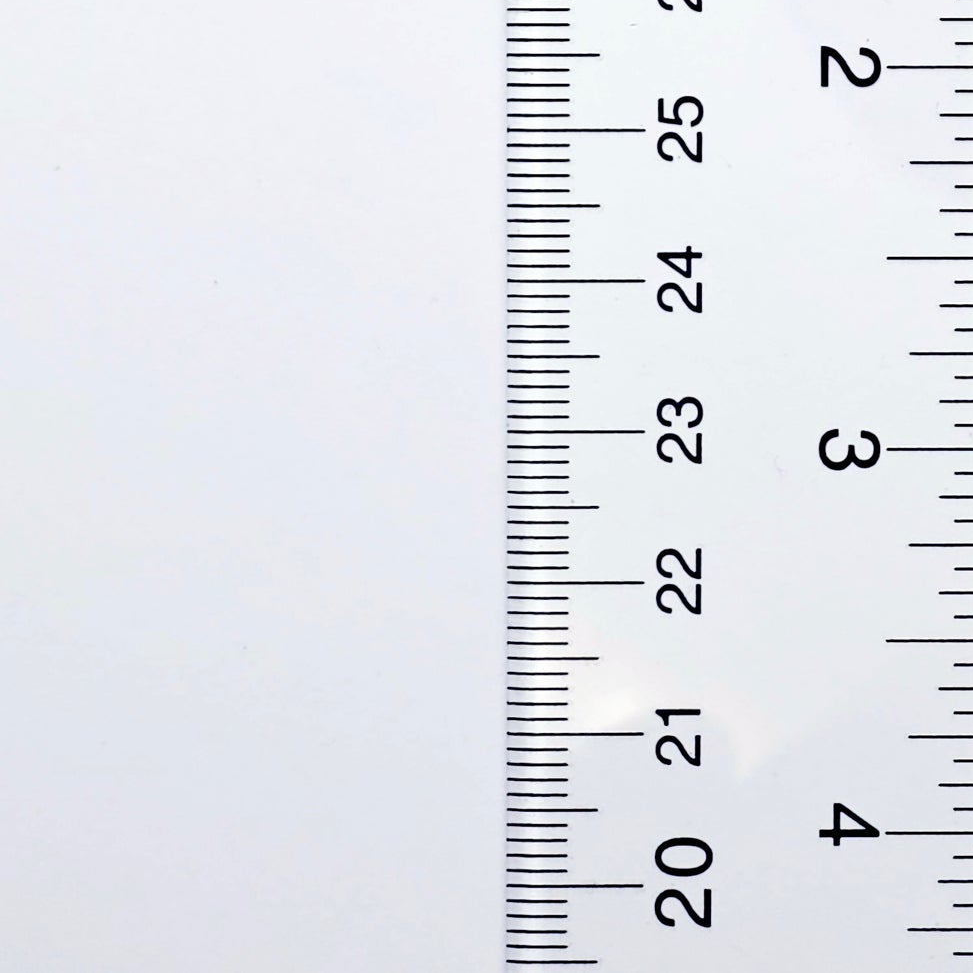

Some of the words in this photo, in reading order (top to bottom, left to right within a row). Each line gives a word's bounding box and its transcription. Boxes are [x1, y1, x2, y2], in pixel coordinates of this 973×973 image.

[820, 45, 882, 88] 2
[657, 95, 704, 164] 25
[656, 245, 703, 314] 24
[656, 396, 704, 465] 23
[818, 428, 881, 471] 3
[655, 547, 702, 615] 22
[655, 708, 702, 767] 21
[818, 802, 880, 847] 4
[654, 837, 714, 929] 20
